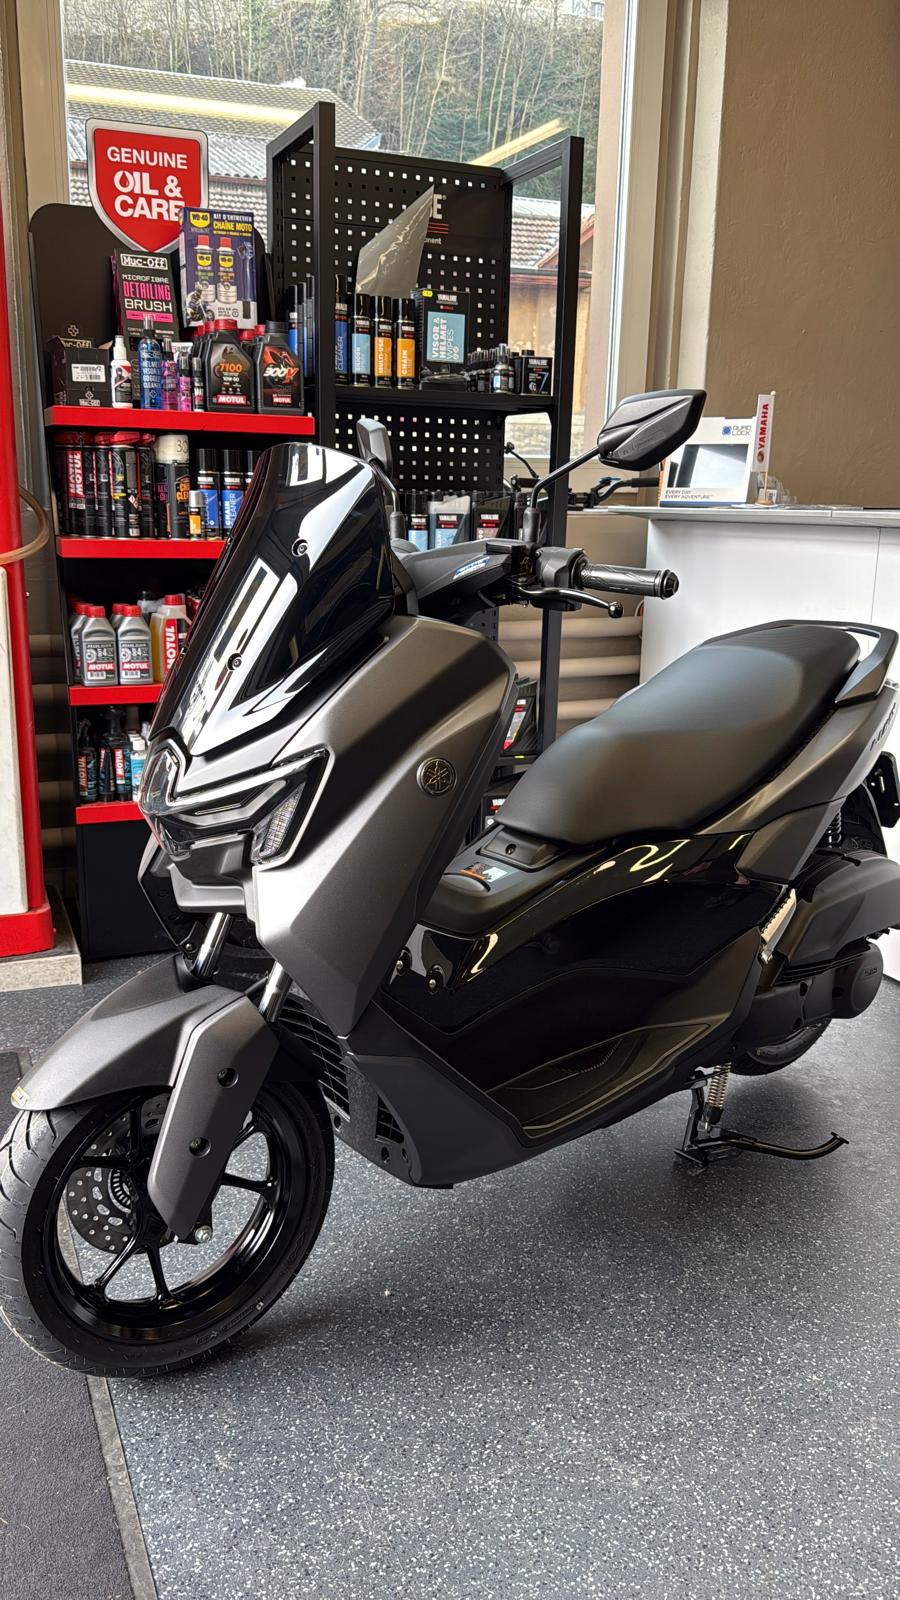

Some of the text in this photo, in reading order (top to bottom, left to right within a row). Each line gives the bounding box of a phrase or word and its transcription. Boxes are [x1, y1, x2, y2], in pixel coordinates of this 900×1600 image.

[107, 146, 188, 170] GENUINE
[114, 170, 183, 199] OIL &
[114, 194, 185, 222] CARE
[213, 219, 234, 231] CHAÎNE
[235, 222, 253, 232] MOTO
[123, 256, 165, 269] Muc-Off
[122, 274, 169, 284] MICROFIBRE
[123, 281, 171, 301] DETAILING
[124, 298, 173, 312] BRUSH
[432, 326, 440, 359] VISOR
[439, 318, 448, 359] HELMET
[446, 328, 454, 360] WIPES
[219, 363, 242, 373] 7100
[218, 395, 246, 404] MOTUL
[758, 403, 769, 450] YAMAHA
[74, 452, 84, 496] MOTUL
[122, 662, 148, 670] MOTUL
[78, 757, 87, 786] MOTUL
[115, 749, 124, 776] MOTUL
